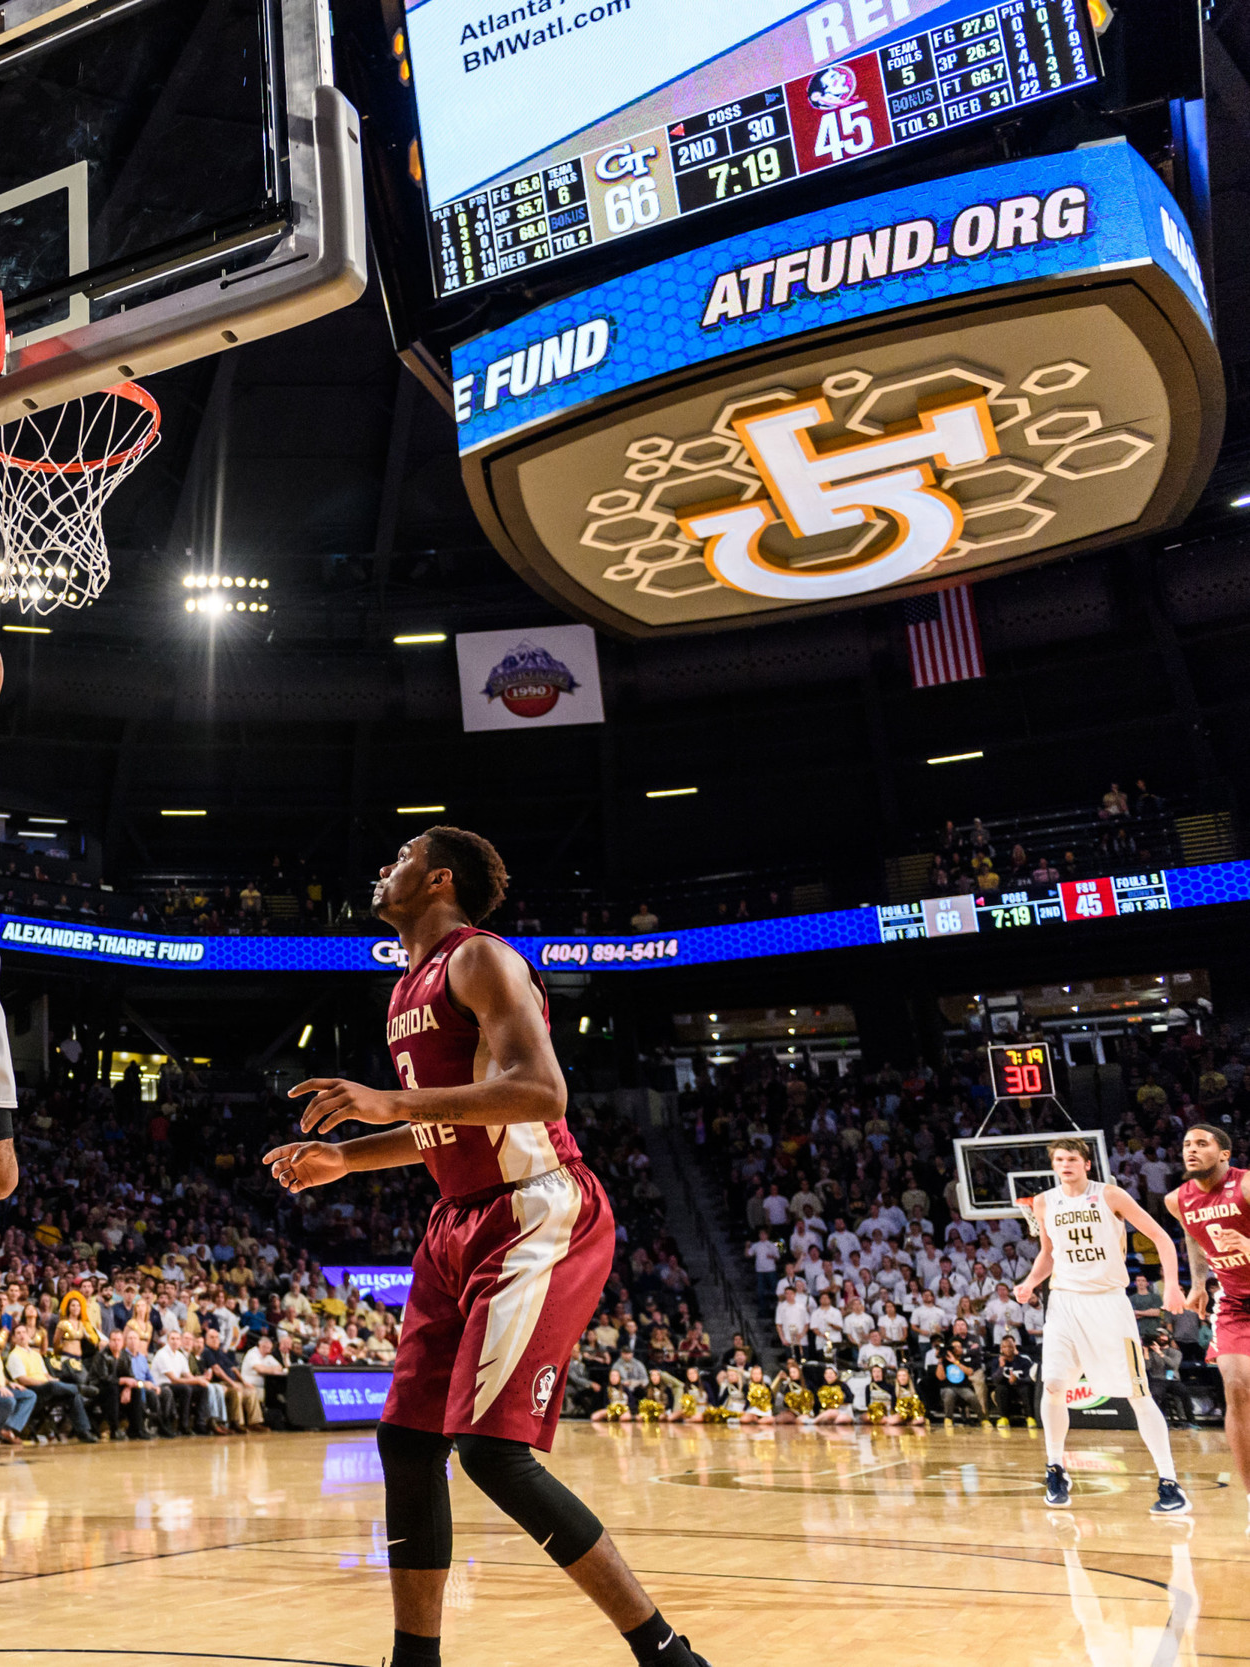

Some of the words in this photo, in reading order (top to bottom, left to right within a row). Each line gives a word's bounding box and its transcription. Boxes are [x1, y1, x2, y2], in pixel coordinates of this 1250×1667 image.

[1001, 2, 1025, 19] PLR
[1011, 16, 1023, 32] 0
[1036, 7, 1048, 23] 0
[1061, 0, 1075, 15] 2
[463, 0, 631, 73] BMWatl.com
[933, 29, 956, 49] FG
[962, 14, 995, 38] 27.6
[1014, 32, 1026, 48] 3
[1041, 23, 1051, 39] 1
[1064, 14, 1076, 30] 7
[887, 51, 923, 71] FOULS
[888, 40, 918, 58] TEAM
[937, 53, 958, 72] 3P
[966, 38, 1000, 63] 26.3
[1018, 48, 1030, 64] 4
[1044, 39, 1055, 55] 1
[1068, 30, 1080, 47] 9
[901, 65, 916, 86] 5
[1017, 62, 1038, 82] 14
[1046, 56, 1058, 72] 3
[1072, 48, 1085, 64] 2
[942, 78, 962, 97] FT
[971, 63, 1005, 87] 66.7
[1020, 79, 1041, 99] 22
[1049, 72, 1061, 88] 3
[1075, 63, 1087, 80] 3
[891, 88, 935, 114] BONUS
[948, 98, 981, 121] REB
[989, 88, 1009, 107] 31
[708, 104, 742, 127] POSS
[897, 120, 927, 138] TOL
[927, 112, 938, 128] 3
[678, 137, 718, 166] 2ND
[748, 116, 775, 142] 30
[814, 101, 874, 161] 45
[548, 163, 573, 180] TEAM
[595, 144, 658, 181] GT
[708, 147, 781, 199] 7:19
[492, 187, 510, 205] FG
[513, 175, 540, 198] 45.8
[549, 172, 578, 191] FOULS
[432, 207, 451, 222] PLR
[454, 203, 465, 214] FL
[469, 194, 487, 208] PTS
[557, 187, 570, 205] 6
[604, 176, 661, 233] 66
[458, 213, 467, 226] 0
[477, 206, 485, 219] 4
[495, 209, 510, 227] 3P
[516, 197, 543, 219] 35.7
[551, 207, 586, 229] BONUS
[441, 233, 451, 247] 5
[460, 227, 469, 241] 3
[475, 219, 490, 235] 31
[497, 231, 513, 249] FT
[519, 220, 546, 241] 68.0
[553, 234, 576, 253] TOL
[441, 246, 455, 262] 11
[461, 241, 471, 255] 3
[480, 235, 489, 249] 0
[443, 260, 458, 276] 12
[463, 255, 472, 269] 0
[480, 248, 494, 263] 11
[500, 252, 526, 271] REB
[533, 243, 549, 260] 41
[701, 187, 1089, 328] ATFUND.ORG
[444, 274, 460, 290] 44
[465, 270, 475, 284] 2
[481, 262, 496, 278] 16
[483, 318, 609, 410] FUND
[512, 686, 546, 697] 1990
[1075, 881, 1097, 894] FSU
[1116, 875, 1147, 888] FOULS
[1001, 891, 1028, 904] POSS
[1075, 893, 1103, 917] 45
[935, 910, 962, 933] 66
[991, 905, 1031, 928] 7:19
[1039, 906, 1060, 918] 2ND
[2, 922, 155, 958] ALEXANDER-THARPE
[157, 943, 204, 962] FUND
[541, 944, 588, 965] (404)
[592, 939, 678, 962] 894-5414
[387, 1004, 440, 1045] LORIDA
[1005, 1049, 1043, 1065] 7:19
[1004, 1065, 1041, 1093] 30
[410, 1122, 457, 1150] TATE
[1054, 1209, 1102, 1227] GEORGIA
[1184, 1203, 1242, 1225] FLORIDA
[1068, 1227, 1093, 1245] 44
[1066, 1247, 1106, 1263] TECH
